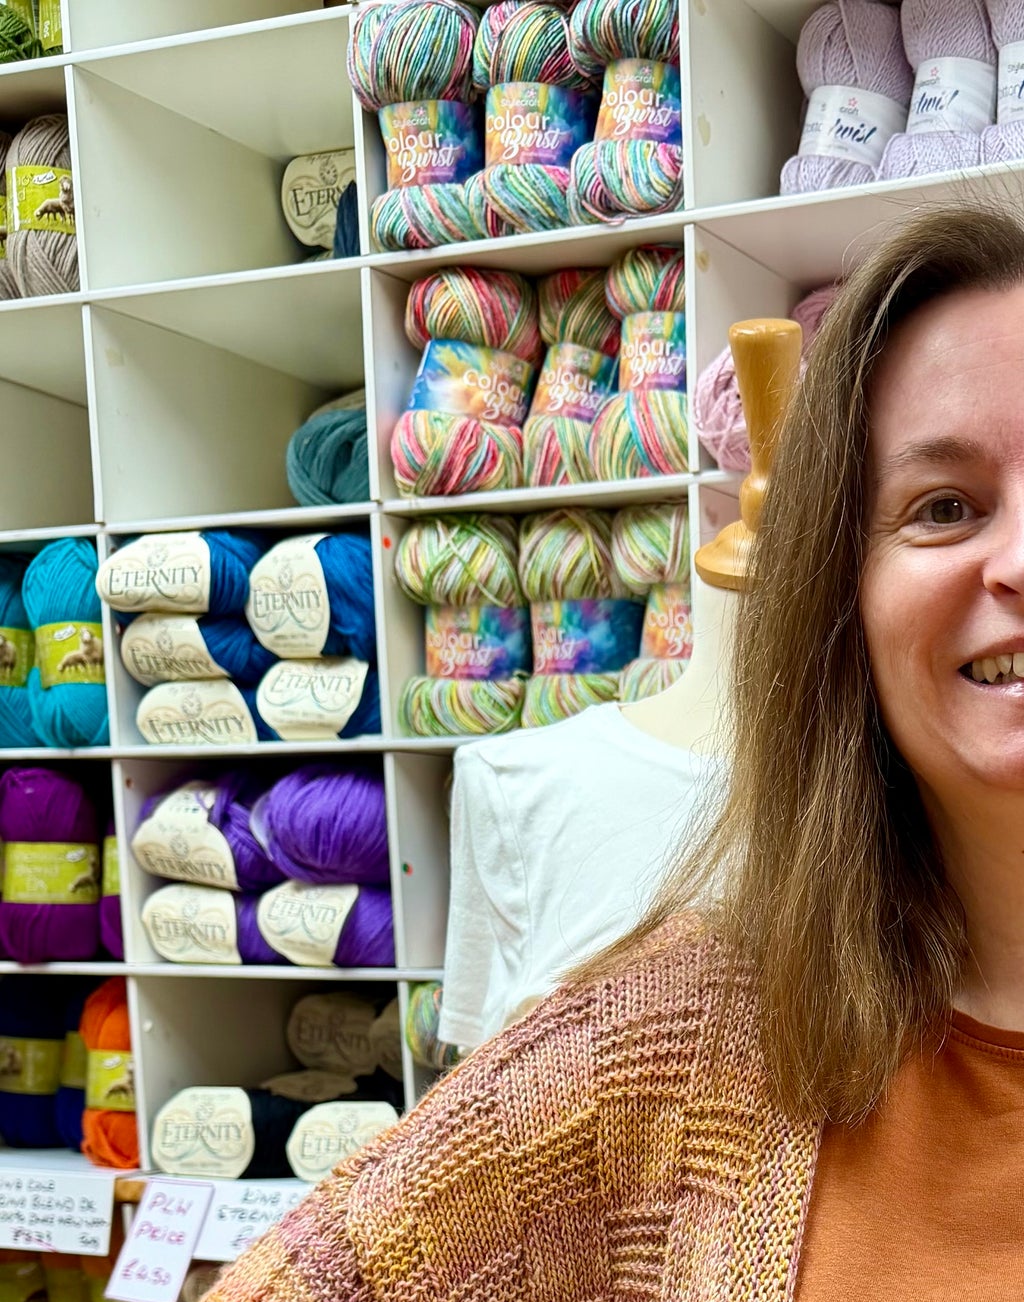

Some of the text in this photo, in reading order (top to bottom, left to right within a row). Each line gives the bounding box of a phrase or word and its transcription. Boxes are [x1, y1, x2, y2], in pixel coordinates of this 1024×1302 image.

[612, 103, 680, 136] Burst
[385, 130, 442, 153] olour
[500, 128, 569, 160] Burst
[397, 143, 462, 183] Burst
